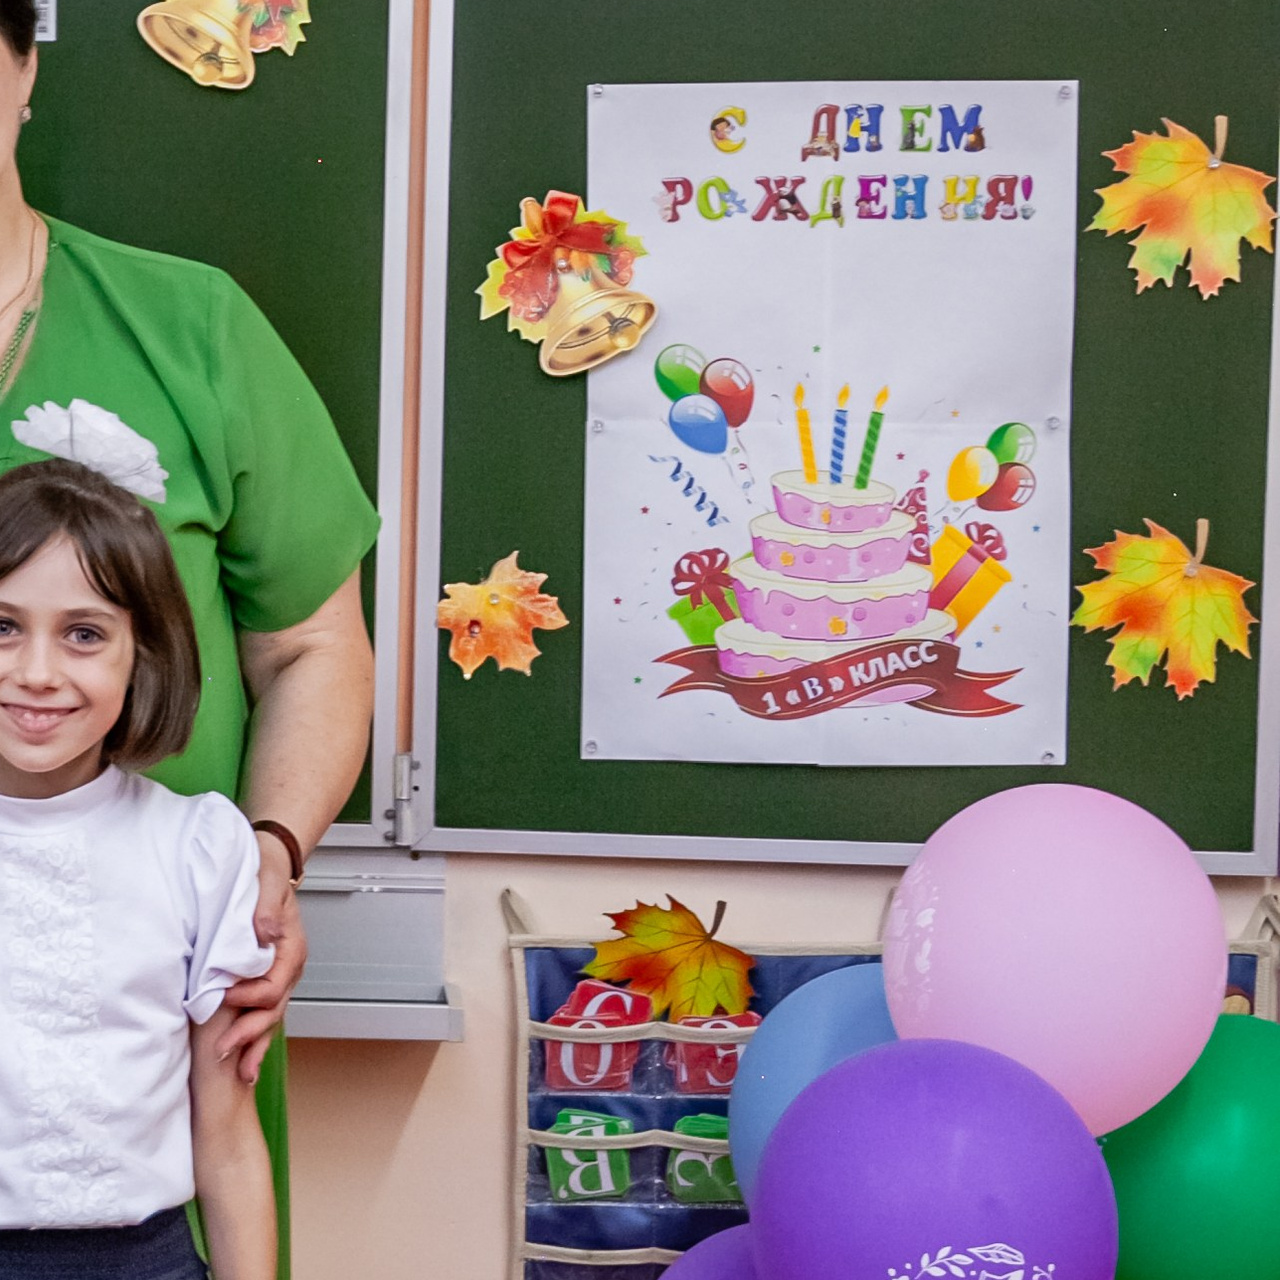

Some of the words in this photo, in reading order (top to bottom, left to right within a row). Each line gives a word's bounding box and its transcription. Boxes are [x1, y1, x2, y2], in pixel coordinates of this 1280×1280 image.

[709, 105, 748, 155] С
[800, 103, 988, 162] ДНЕМ
[658, 173, 1034, 228] РОЖДЕНИЯ!
[761, 691, 781, 715] 1
[848, 641, 939, 688] КЛАСС
